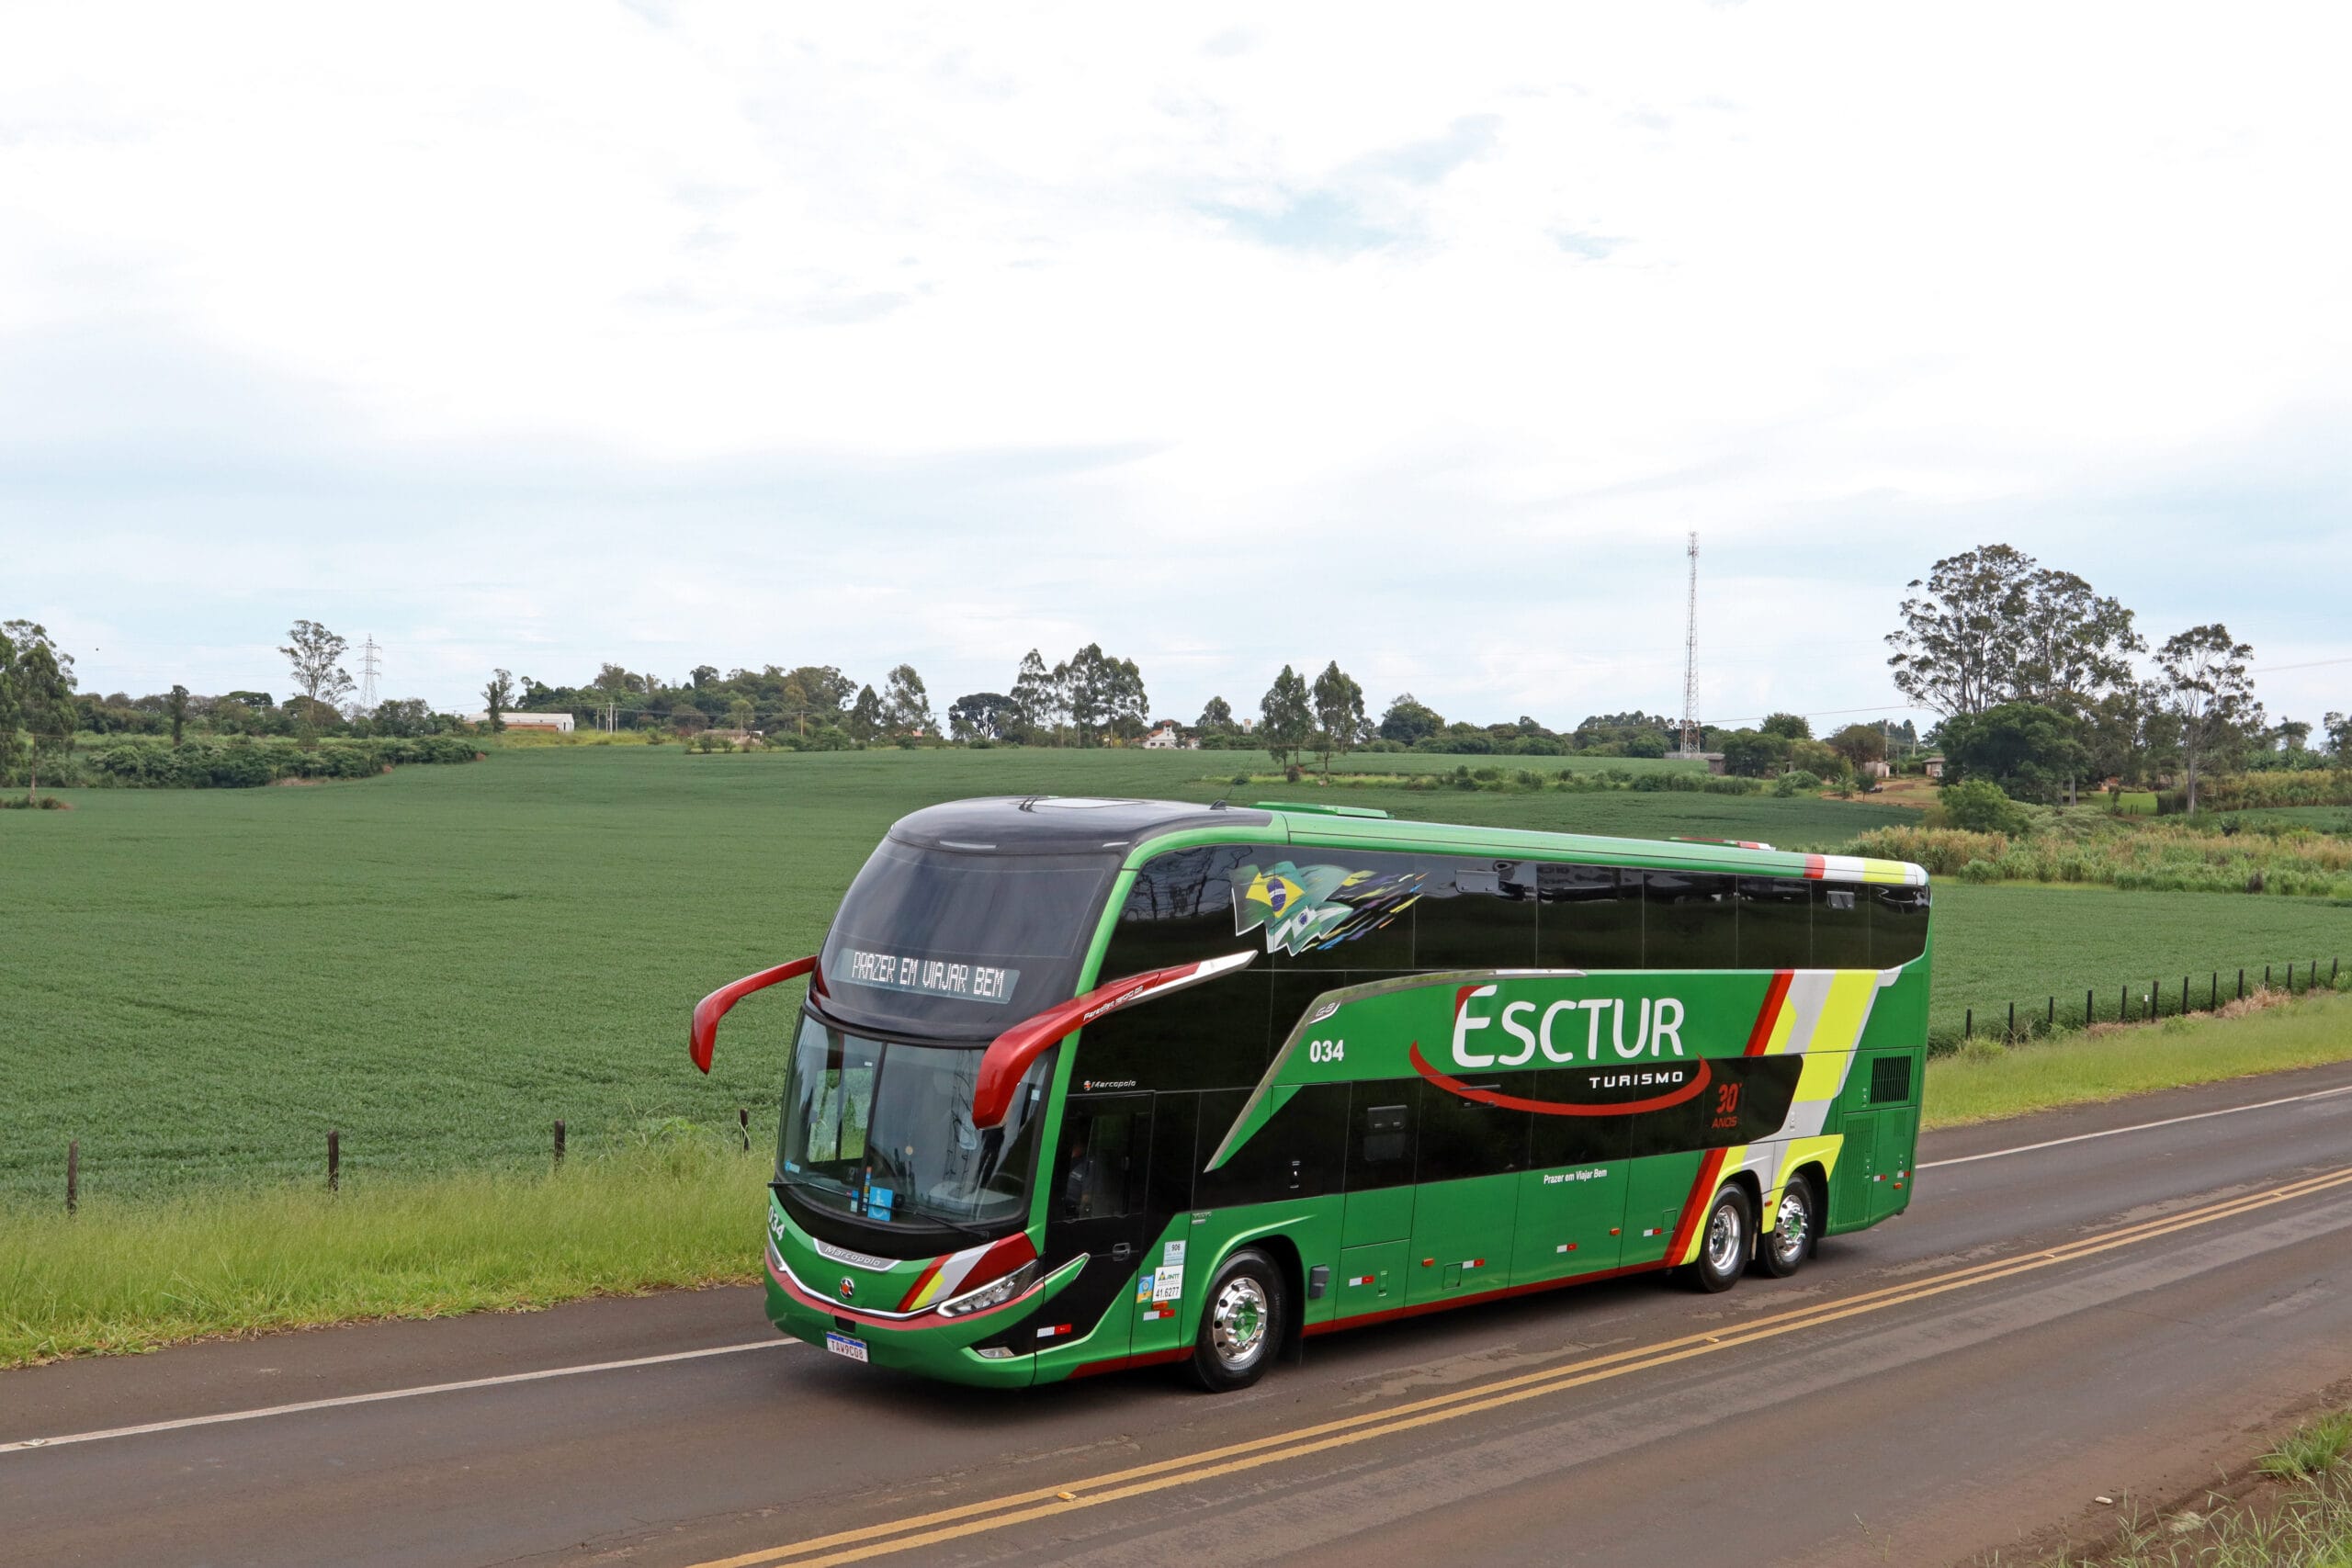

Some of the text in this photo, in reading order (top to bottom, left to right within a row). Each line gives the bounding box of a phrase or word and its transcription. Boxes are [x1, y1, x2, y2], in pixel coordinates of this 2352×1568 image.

[852, 952, 1005, 998] PRAZER EM VIAJAR BEM
[1309, 1039, 1344, 1063] 034
[1091, 1080, 1136, 1089] Marcopolo
[1589, 1071, 1683, 1089] TURISMO
[1712, 1116, 1737, 1128] ANOS
[1544, 1168, 1608, 1184] Prazer em Viajar Bem
[768, 1204, 786, 1241] 034
[825, 1246, 882, 1267] Marcopolo
